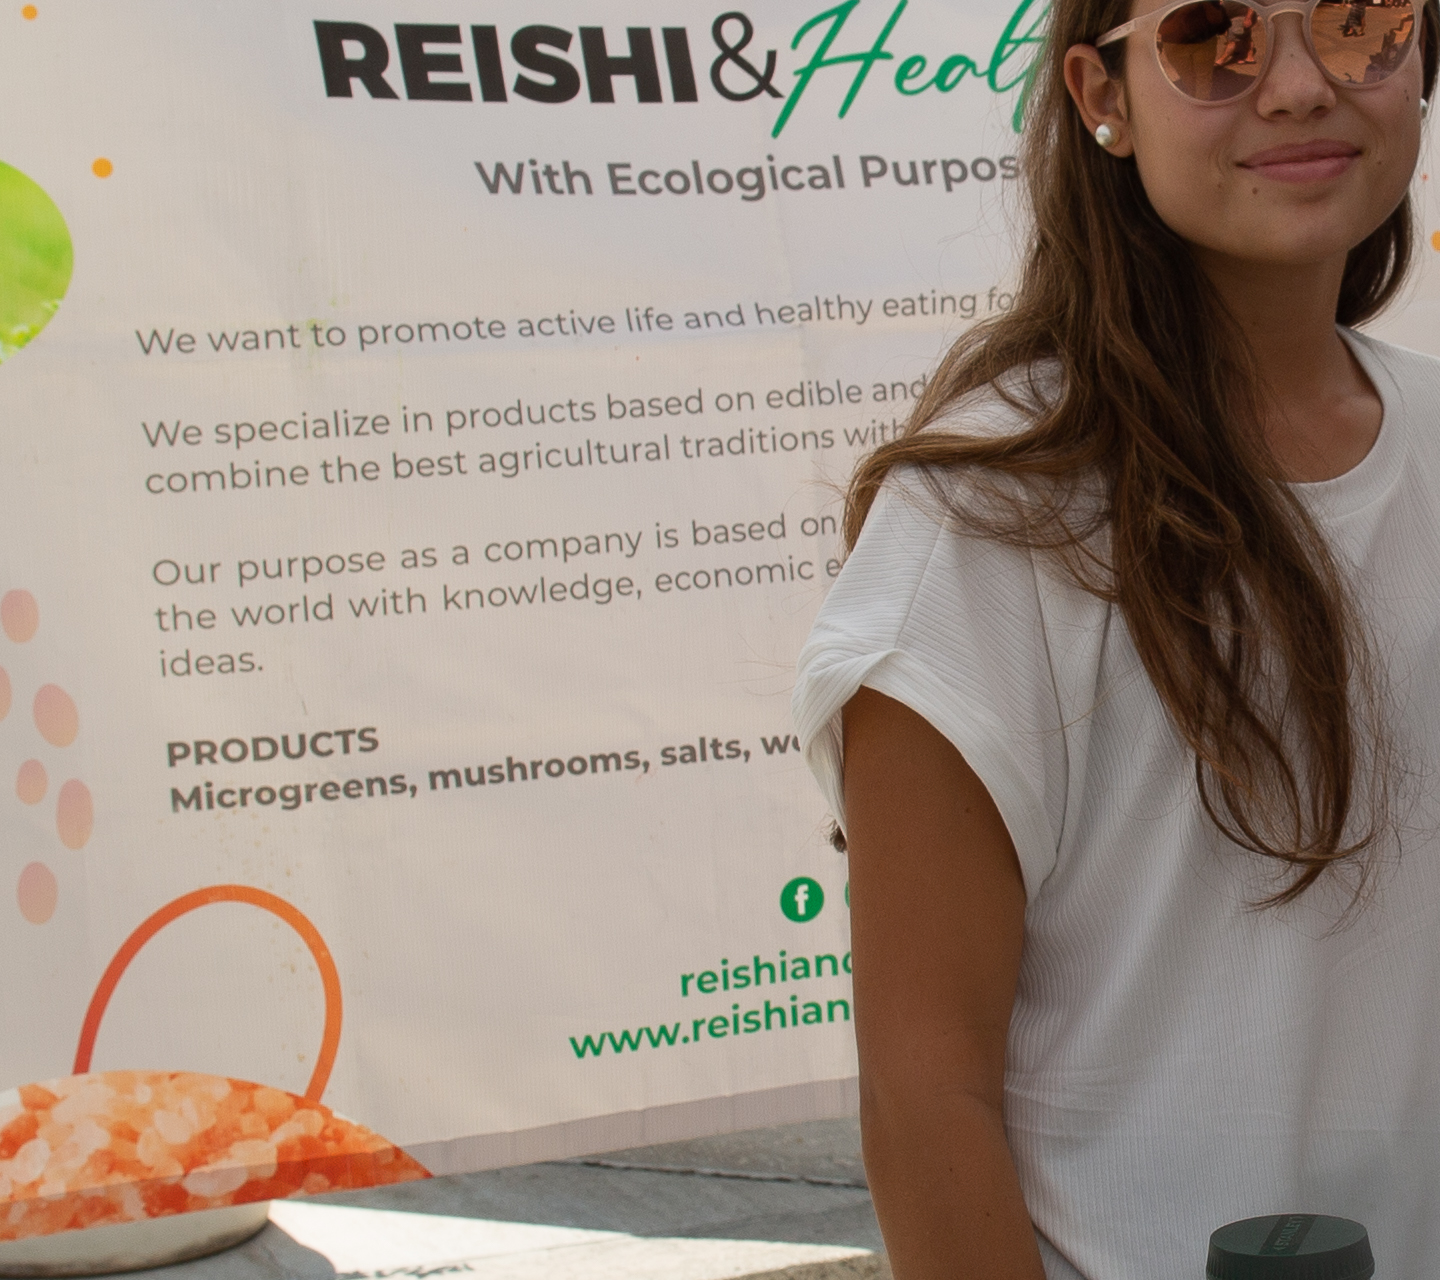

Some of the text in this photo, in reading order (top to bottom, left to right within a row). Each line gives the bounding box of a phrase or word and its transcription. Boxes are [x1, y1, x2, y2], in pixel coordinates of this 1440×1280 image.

[474, 154, 1022, 202] With Ecological Purpos
[135, 286, 1015, 356] We want to promote active life and healthy eating fo
[141, 420, 202, 448] We
[215, 409, 390, 449] specialize
[402, 405, 433, 433] in
[446, 399, 596, 437] products
[607, 387, 703, 419] based
[715, 391, 755, 412] on
[766, 379, 862, 409] edible
[145, 460, 309, 495] combine
[320, 456, 380, 484] the
[392, 451, 468, 479] best
[479, 434, 670, 478] agricultural
[680, 426, 835, 459] traditions
[152, 512, 836, 593] Our purpose as a company is based on
[154, 604, 216, 632] the
[231, 593, 333, 627] world
[348, 587, 426, 618] with
[443, 573, 642, 611] knowledge,
[655, 555, 814, 593] economic
[160, 649, 263, 677] ideas.
[167, 727, 379, 768] PRODUCTS
[170, 774, 417, 813] Microgreens,
[428, 750, 650, 791] mushrooms,
[660, 737, 751, 766] salts,
[569, 995, 851, 1059] www.reishian
